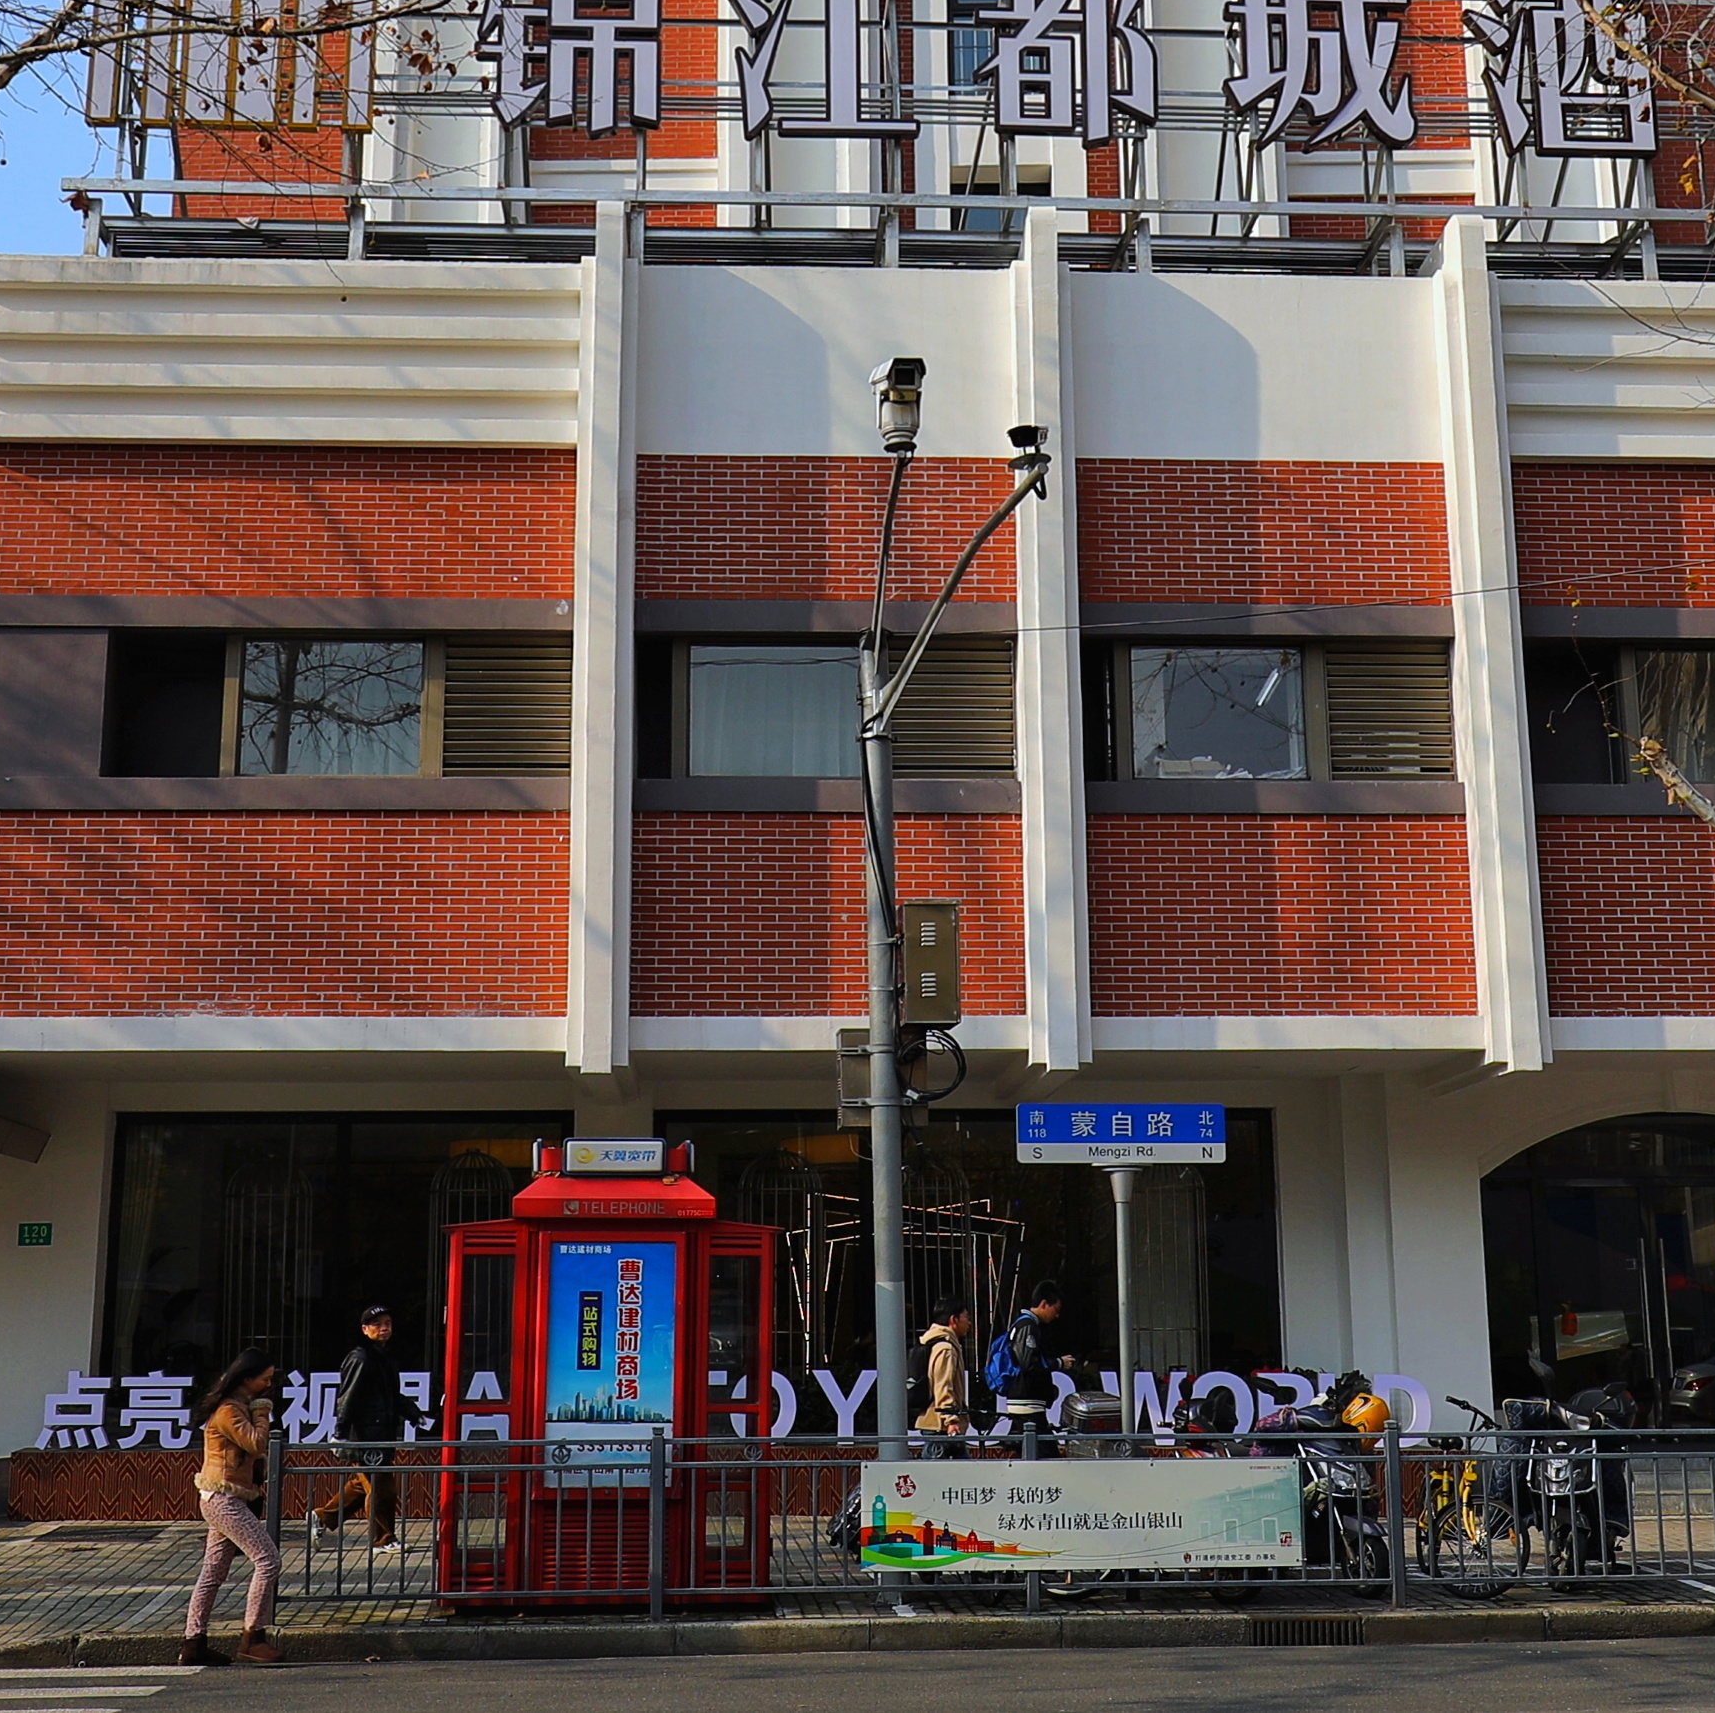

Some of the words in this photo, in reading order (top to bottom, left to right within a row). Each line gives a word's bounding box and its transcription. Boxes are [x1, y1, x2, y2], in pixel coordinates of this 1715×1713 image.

[1029, 1110, 1044, 1125] 南
[1071, 1111, 1174, 1137] 蒙自路
[1198, 1110, 1214, 1125] 北
[1028, 1128, 1047, 1138] 118
[1199, 1128, 1213, 1138] 74
[598, 1149, 657, 1162] 天翼宽带
[1032, 1147, 1043, 1159] S
[1088, 1146, 1131, 1159] Mengzi
[1136, 1146, 1156, 1157] Rd.
[1202, 1147, 1213, 1158] N
[583, 1201, 665, 1215] TELEPHONE
[23, 1225, 48, 1237] 120
[581, 1295, 599, 1367] 一站式购物
[615, 1258, 643, 1401] 曹达建材商场
[941, 1487, 997, 1505] 中国梦
[1007, 1486, 1063, 1505] 我的梦
[997, 1512, 1183, 1531] 绿水青山就是金山银山
